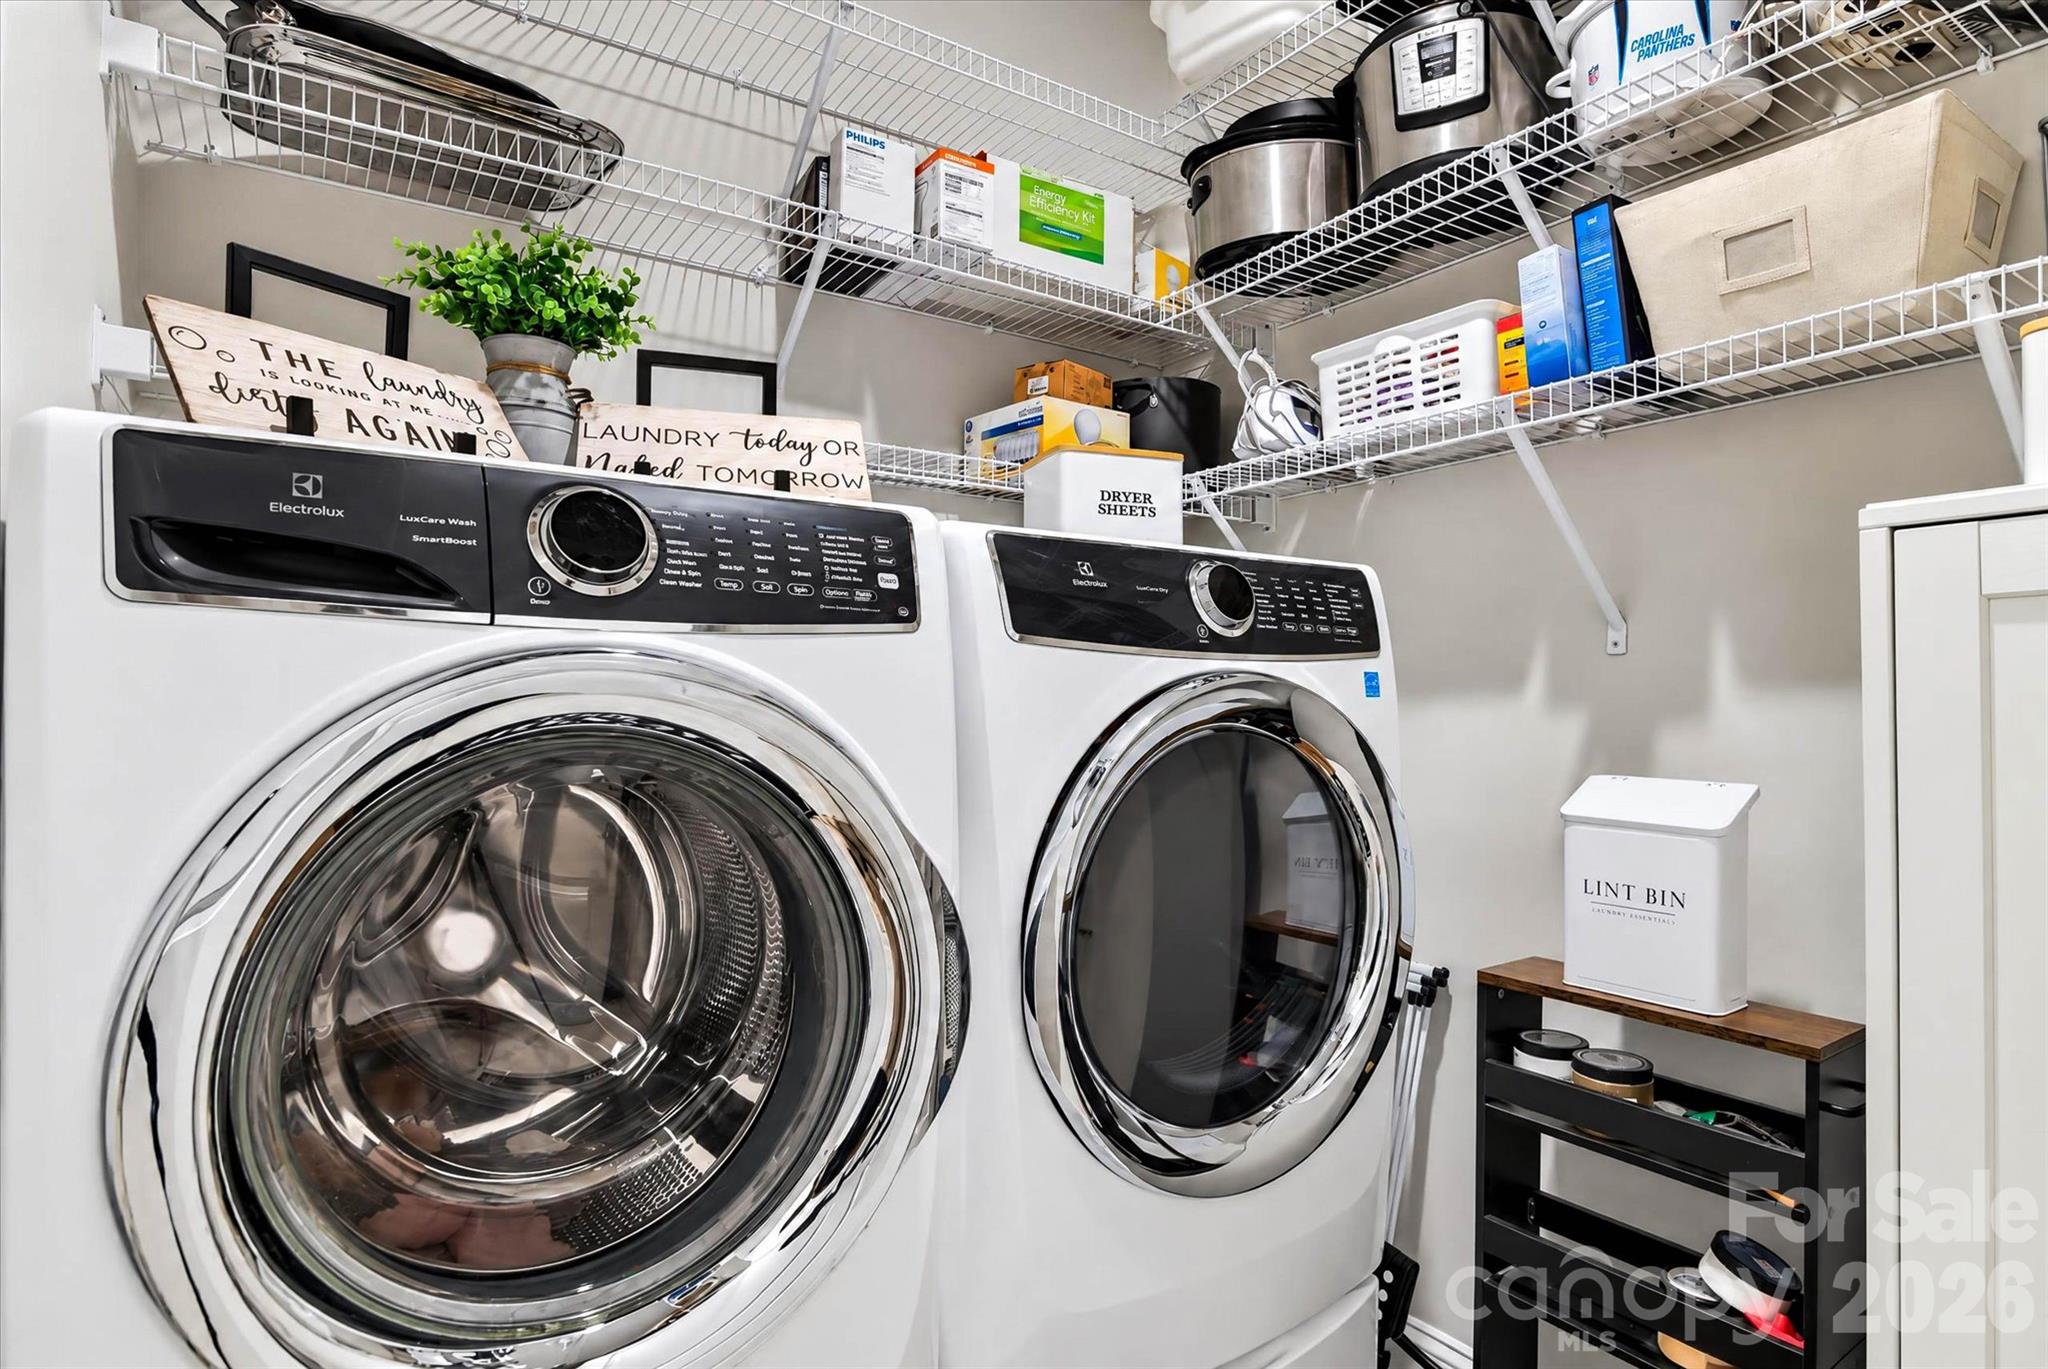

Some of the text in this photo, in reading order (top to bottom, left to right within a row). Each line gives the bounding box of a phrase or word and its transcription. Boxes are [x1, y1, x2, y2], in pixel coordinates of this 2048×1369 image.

[1630, 23, 1685, 53] CAROLINA
[1636, 33, 1696, 63] PANTHERS
[846, 129, 886, 150] PHILIPS
[1033, 184, 1067, 206] Energy
[1028, 195, 1080, 223] Efficiency
[1082, 210, 1096, 225] Kit
[249, 337, 485, 425] THE laundry
[259, 368, 280, 380] IS
[289, 375, 372, 402] LOOKING
[382, 398, 401, 409] AT
[208, 370, 320, 433] dirt
[583, 421, 861, 467] LAUNDRY today OR
[1099, 489, 1154, 505] DRYER
[268, 501, 345, 518] Electrolux
[1097, 502, 1157, 518] SHEETS
[399, 514, 477, 527] LuxCare Wash
[411, 534, 478, 546] SmartBoost
[719, 580, 739, 590] Temp
[793, 586, 809, 596] Spin
[1072, 578, 1109, 589] Electrolux
[1583, 878, 1687, 909] LINT BIN
[1591, 906, 1677, 926] LAUNDRY ESSENTIALS
